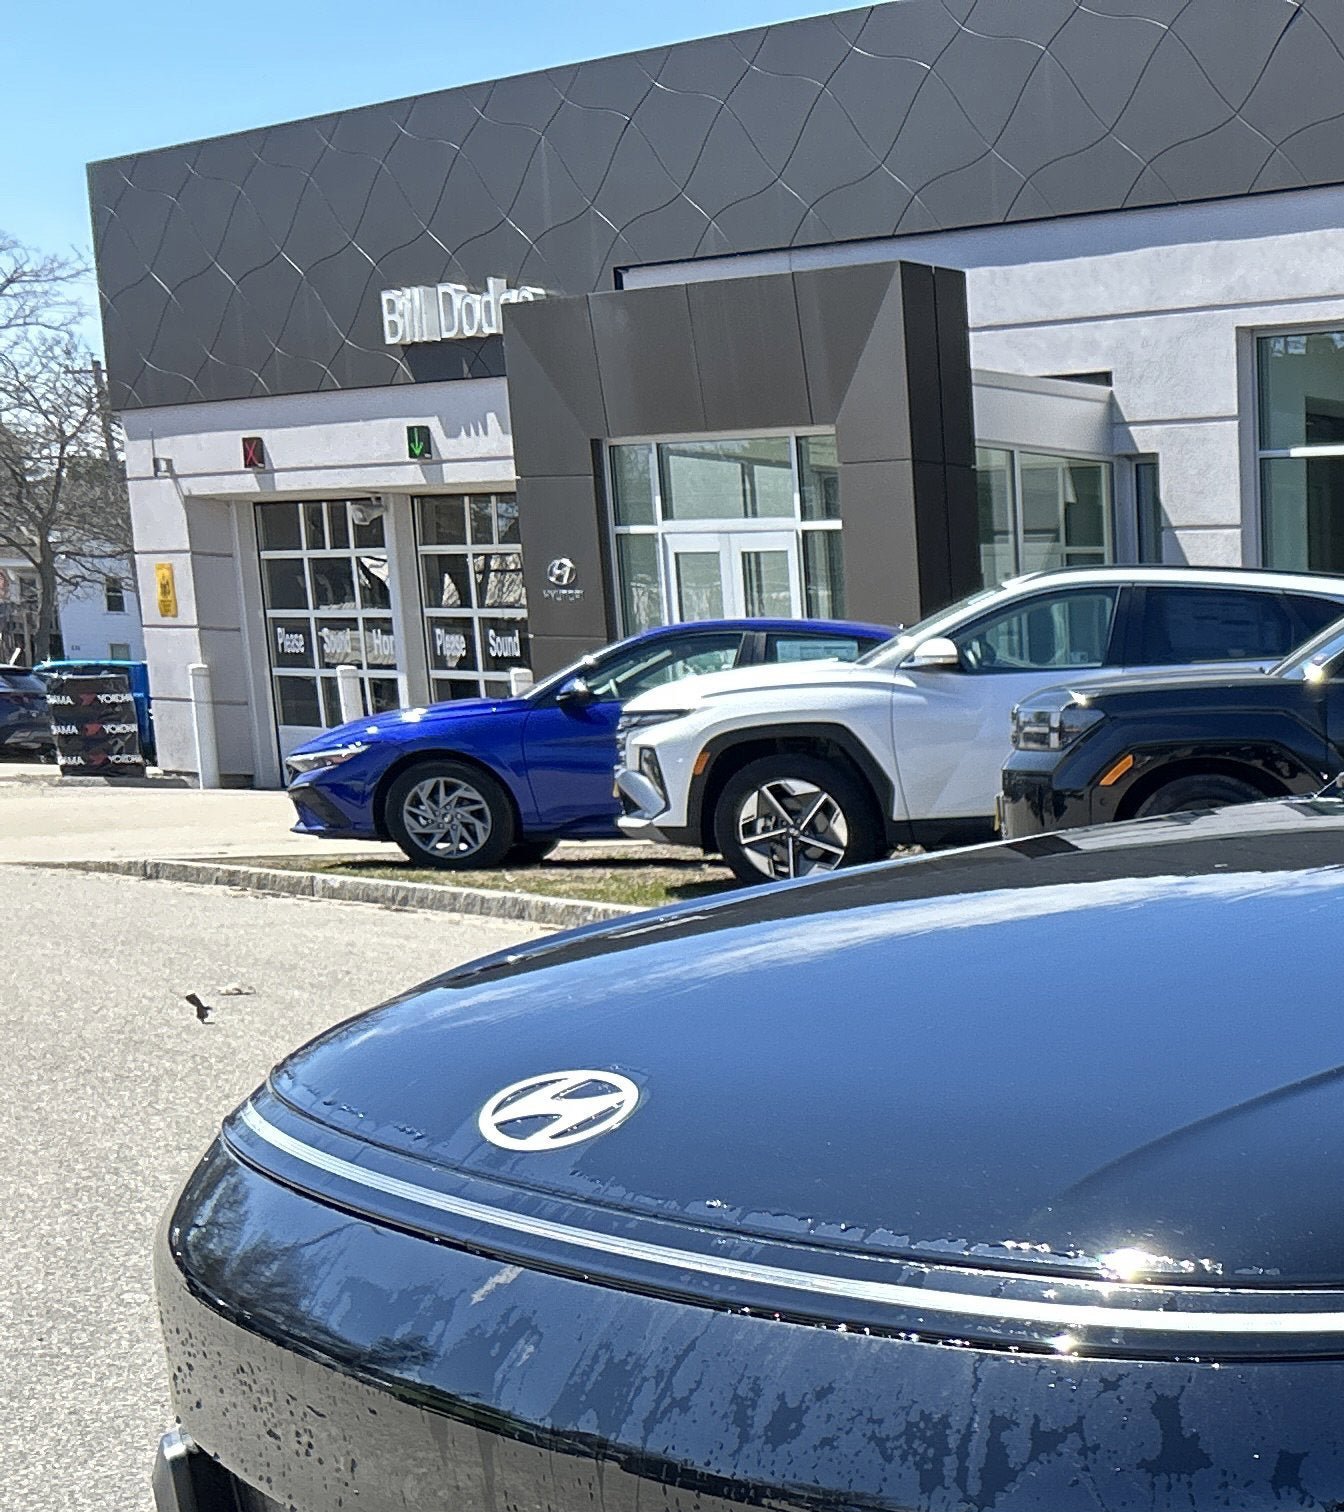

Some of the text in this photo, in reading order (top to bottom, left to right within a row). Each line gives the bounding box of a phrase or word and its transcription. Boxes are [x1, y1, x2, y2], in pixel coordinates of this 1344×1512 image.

[381, 276, 547, 345] Bill Dod
[276, 627, 395, 655] Please Sound Hor
[434, 627, 521, 657] Please Sound
